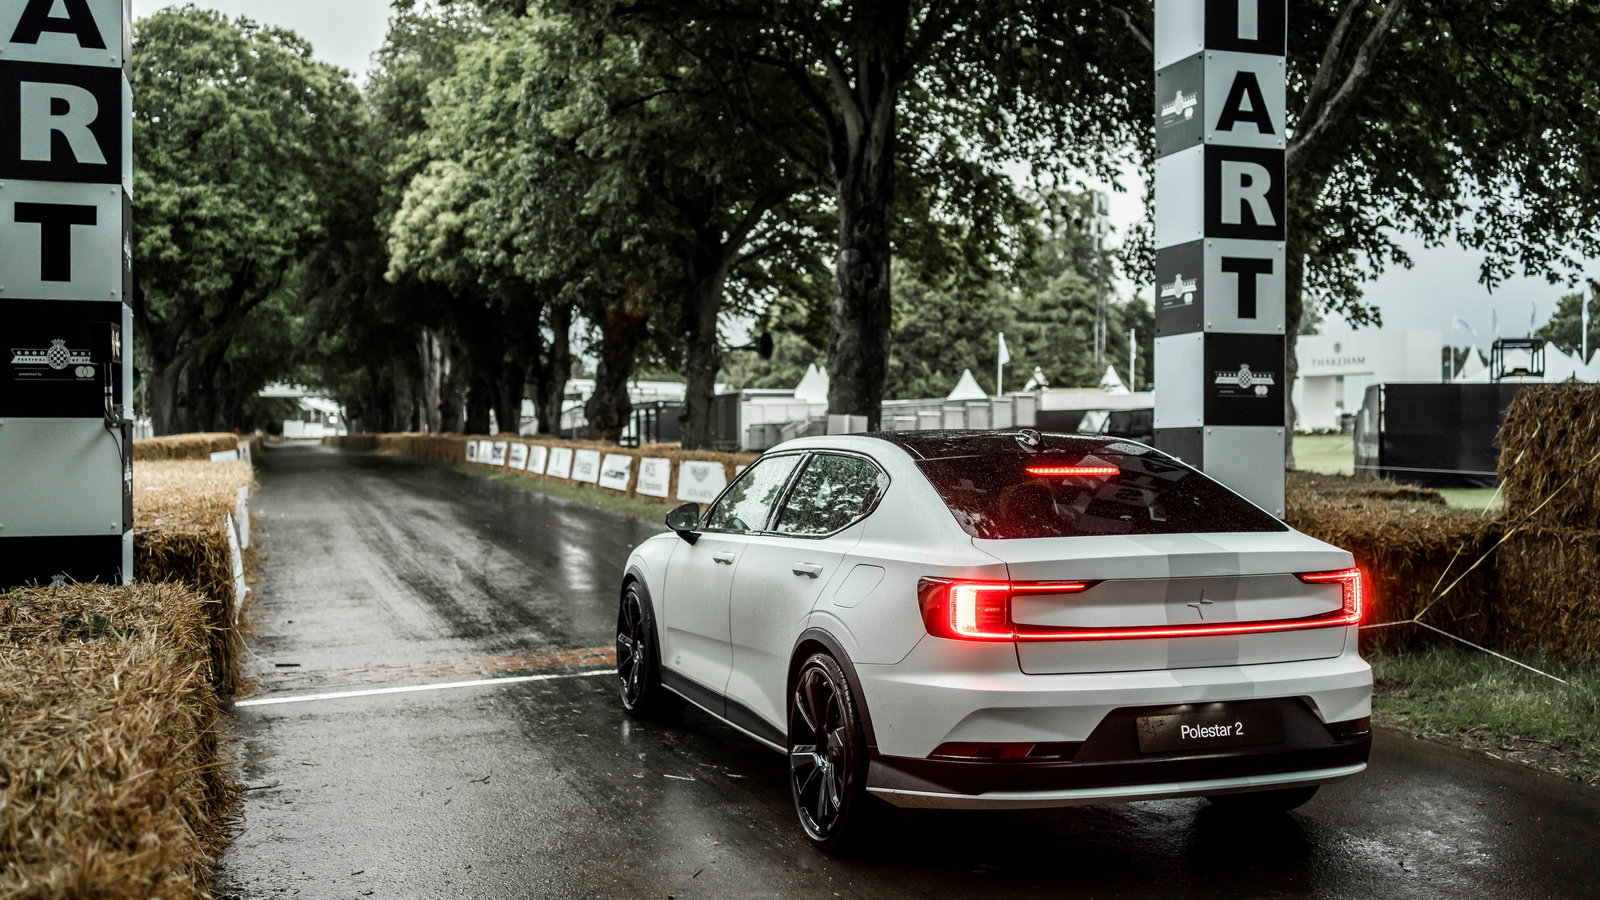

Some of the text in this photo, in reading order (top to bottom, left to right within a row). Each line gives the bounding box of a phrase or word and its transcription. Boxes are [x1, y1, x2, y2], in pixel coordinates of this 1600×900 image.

[1311, 356, 1366, 368] THAKEHAM
[1180, 721, 1244, 740] Polestar 2
